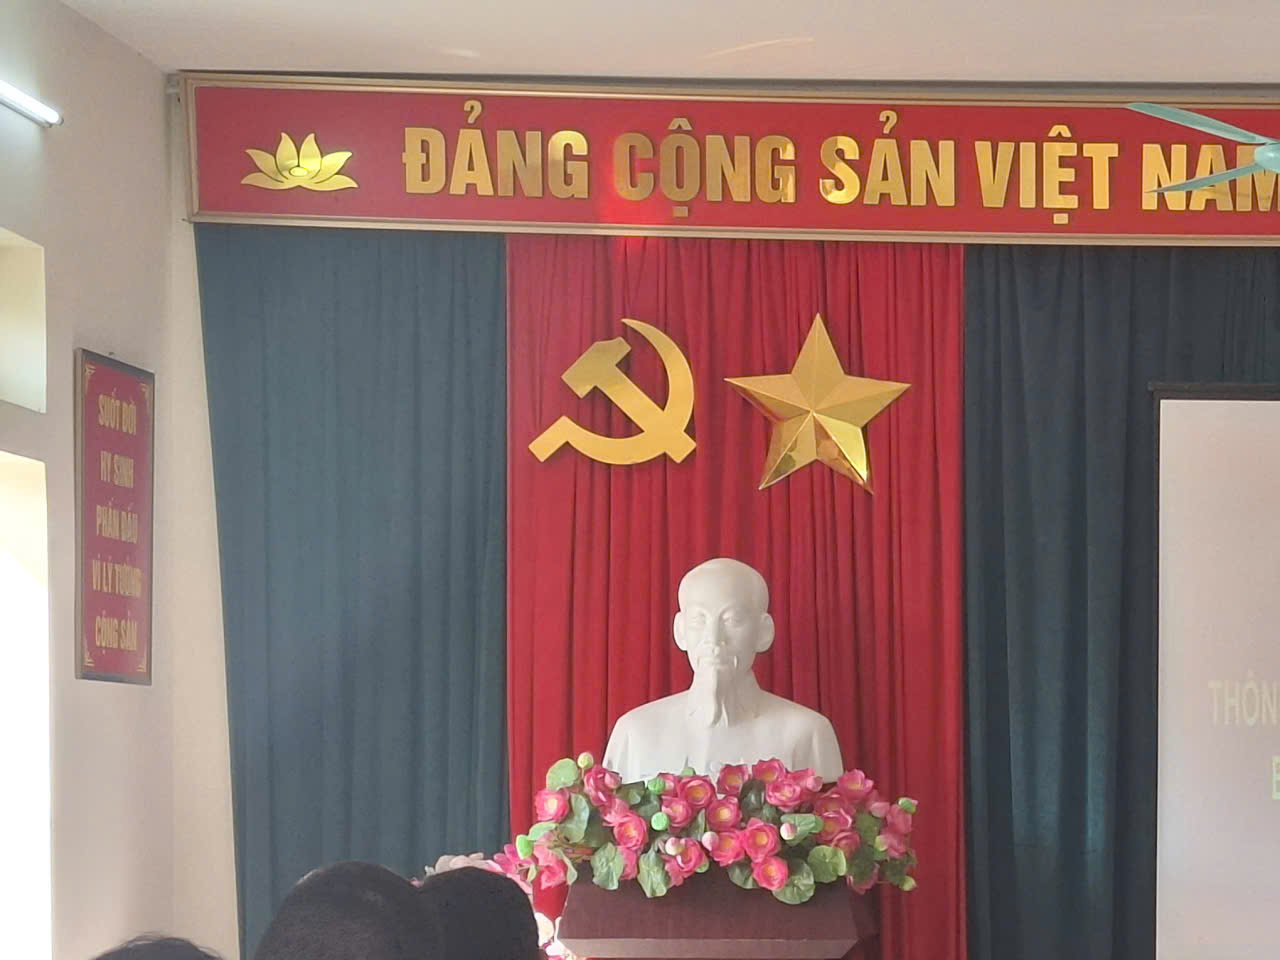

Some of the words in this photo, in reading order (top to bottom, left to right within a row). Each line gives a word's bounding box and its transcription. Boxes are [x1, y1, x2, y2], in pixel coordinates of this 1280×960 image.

[402, 99, 589, 199] ĐẢNG
[613, 117, 797, 218] CỘNG
[818, 110, 956, 208] SẢN
[974, 124, 1119, 226] VIỆT
